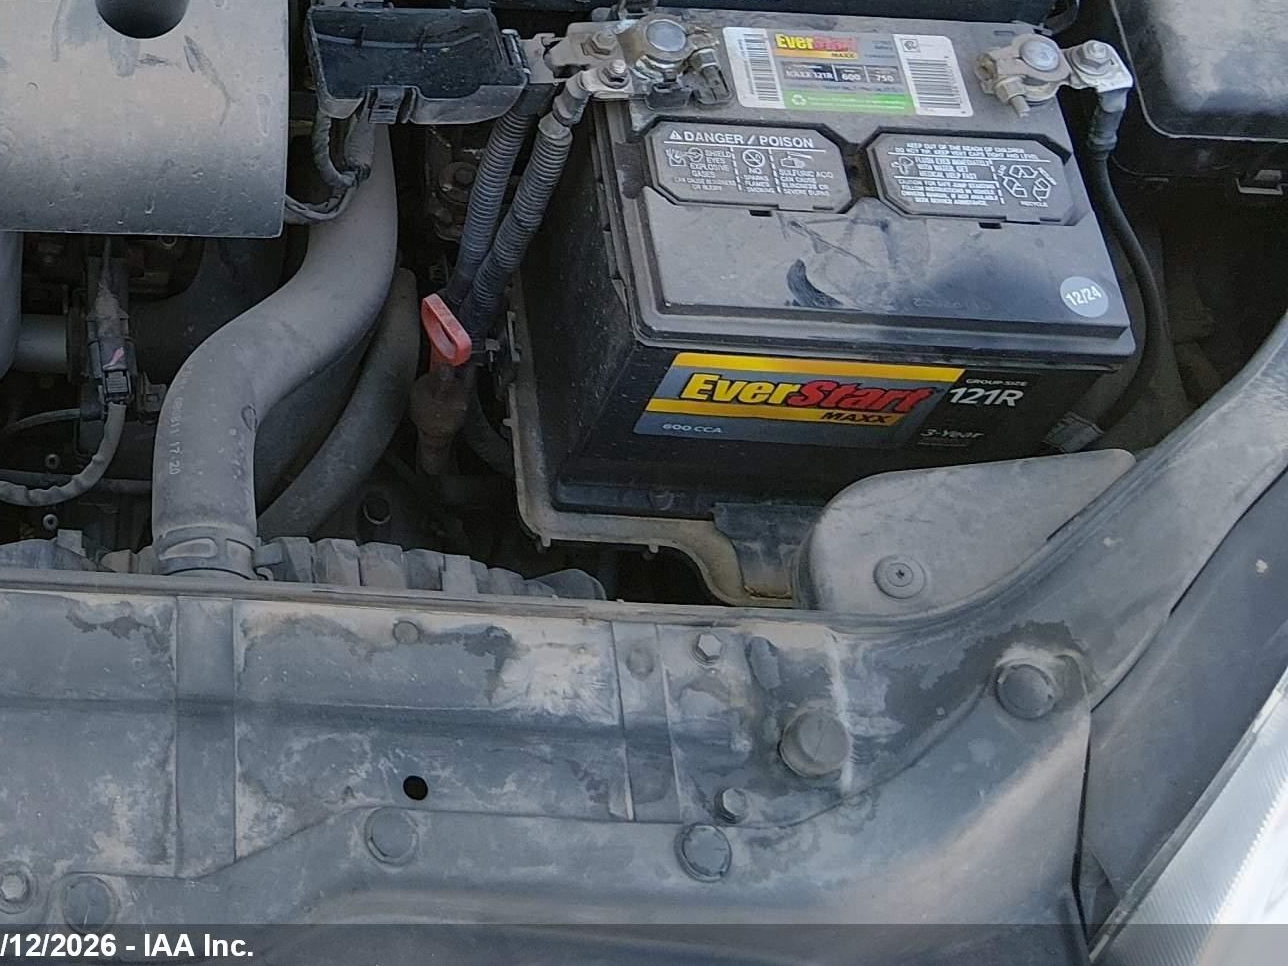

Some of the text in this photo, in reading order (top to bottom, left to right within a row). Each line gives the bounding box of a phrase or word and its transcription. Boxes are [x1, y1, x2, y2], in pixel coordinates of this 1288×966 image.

[842, 72, 861, 82] 600
[875, 73, 894, 82] 750
[683, 132, 814, 148] DANGER / POISON
[704, 150, 732, 158] SHIELD
[707, 156, 726, 164] EYES
[690, 163, 730, 172] EXPLOSIVE
[779, 169, 833, 179] SULFURIC ACID
[1064, 286, 1102, 306] 12/24
[680, 372, 933, 413] EverStart
[949, 387, 1025, 407] 121R
[821, 411, 890, 424] MAXX
[662, 423, 722, 434] 600 CCA
